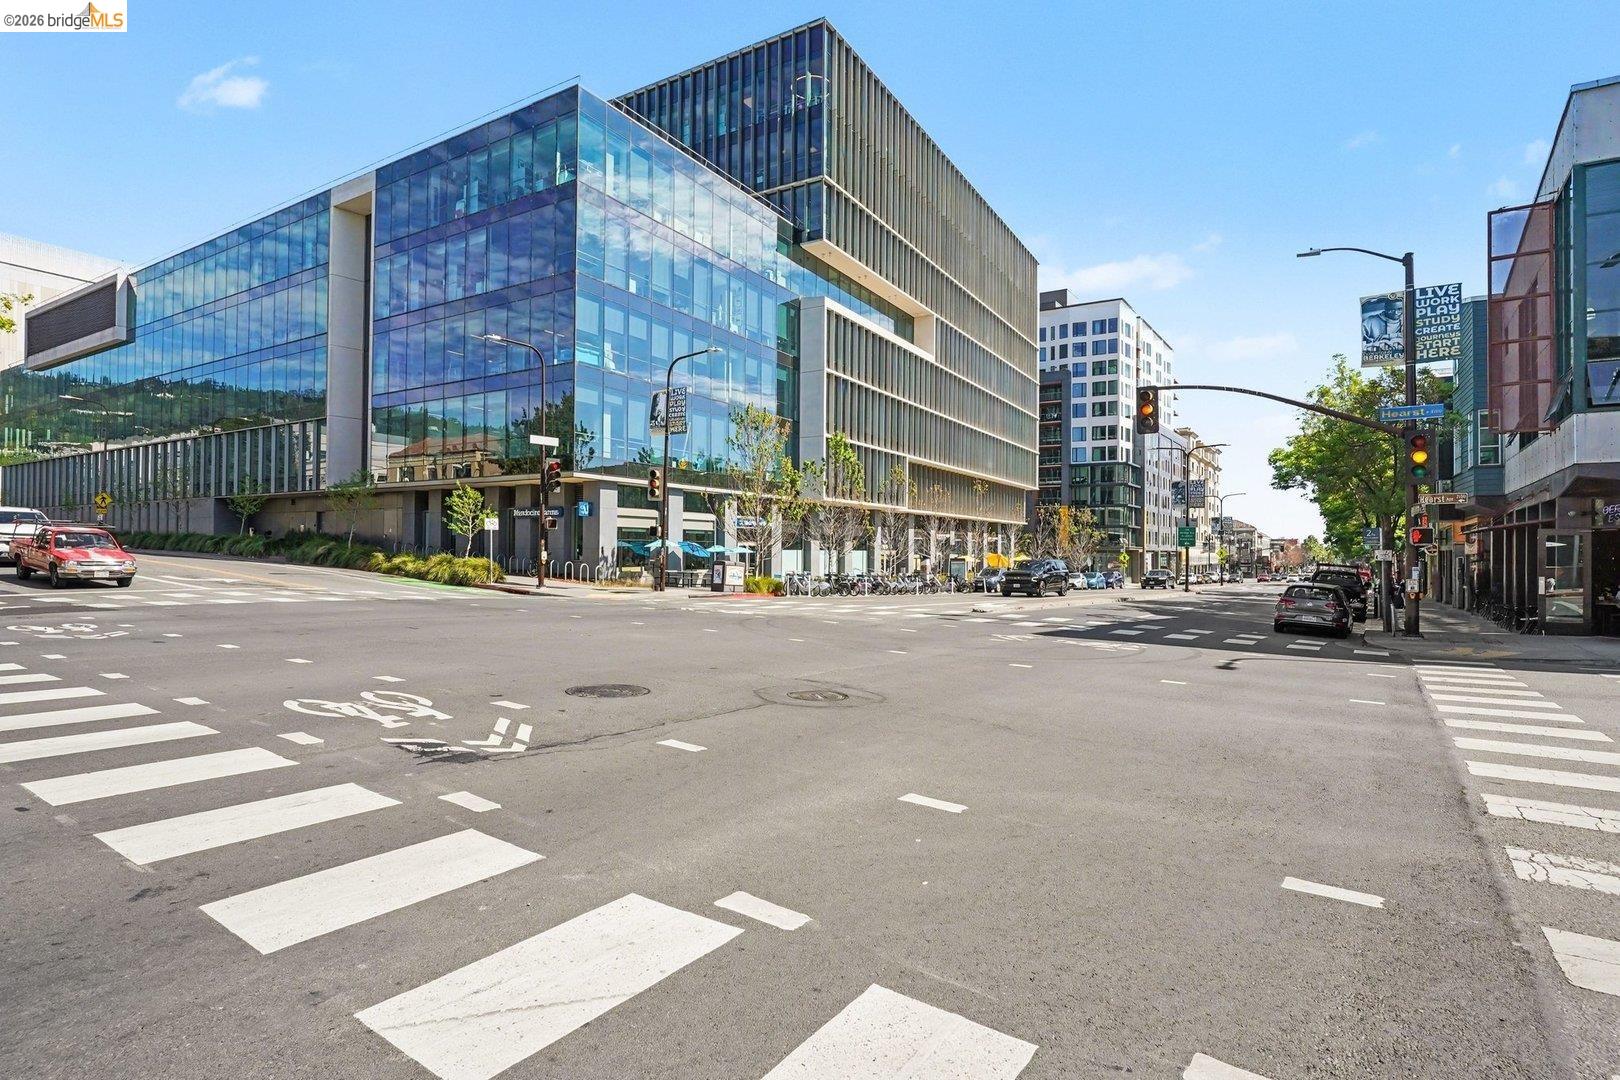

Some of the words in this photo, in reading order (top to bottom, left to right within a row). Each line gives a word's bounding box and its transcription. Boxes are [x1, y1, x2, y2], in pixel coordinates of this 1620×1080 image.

[1415, 284, 1459, 299] LIVE
[1415, 294, 1460, 308] WORK
[1416, 303, 1460, 318] PLAY
[1415, 314, 1460, 327] STUDY
[1415, 322, 1460, 335] CREATE
[1416, 331, 1461, 342] JOURNEYS
[1416, 337, 1460, 350] START
[1416, 345, 1461, 359] HERE
[1381, 409, 1425, 418] Hearst
